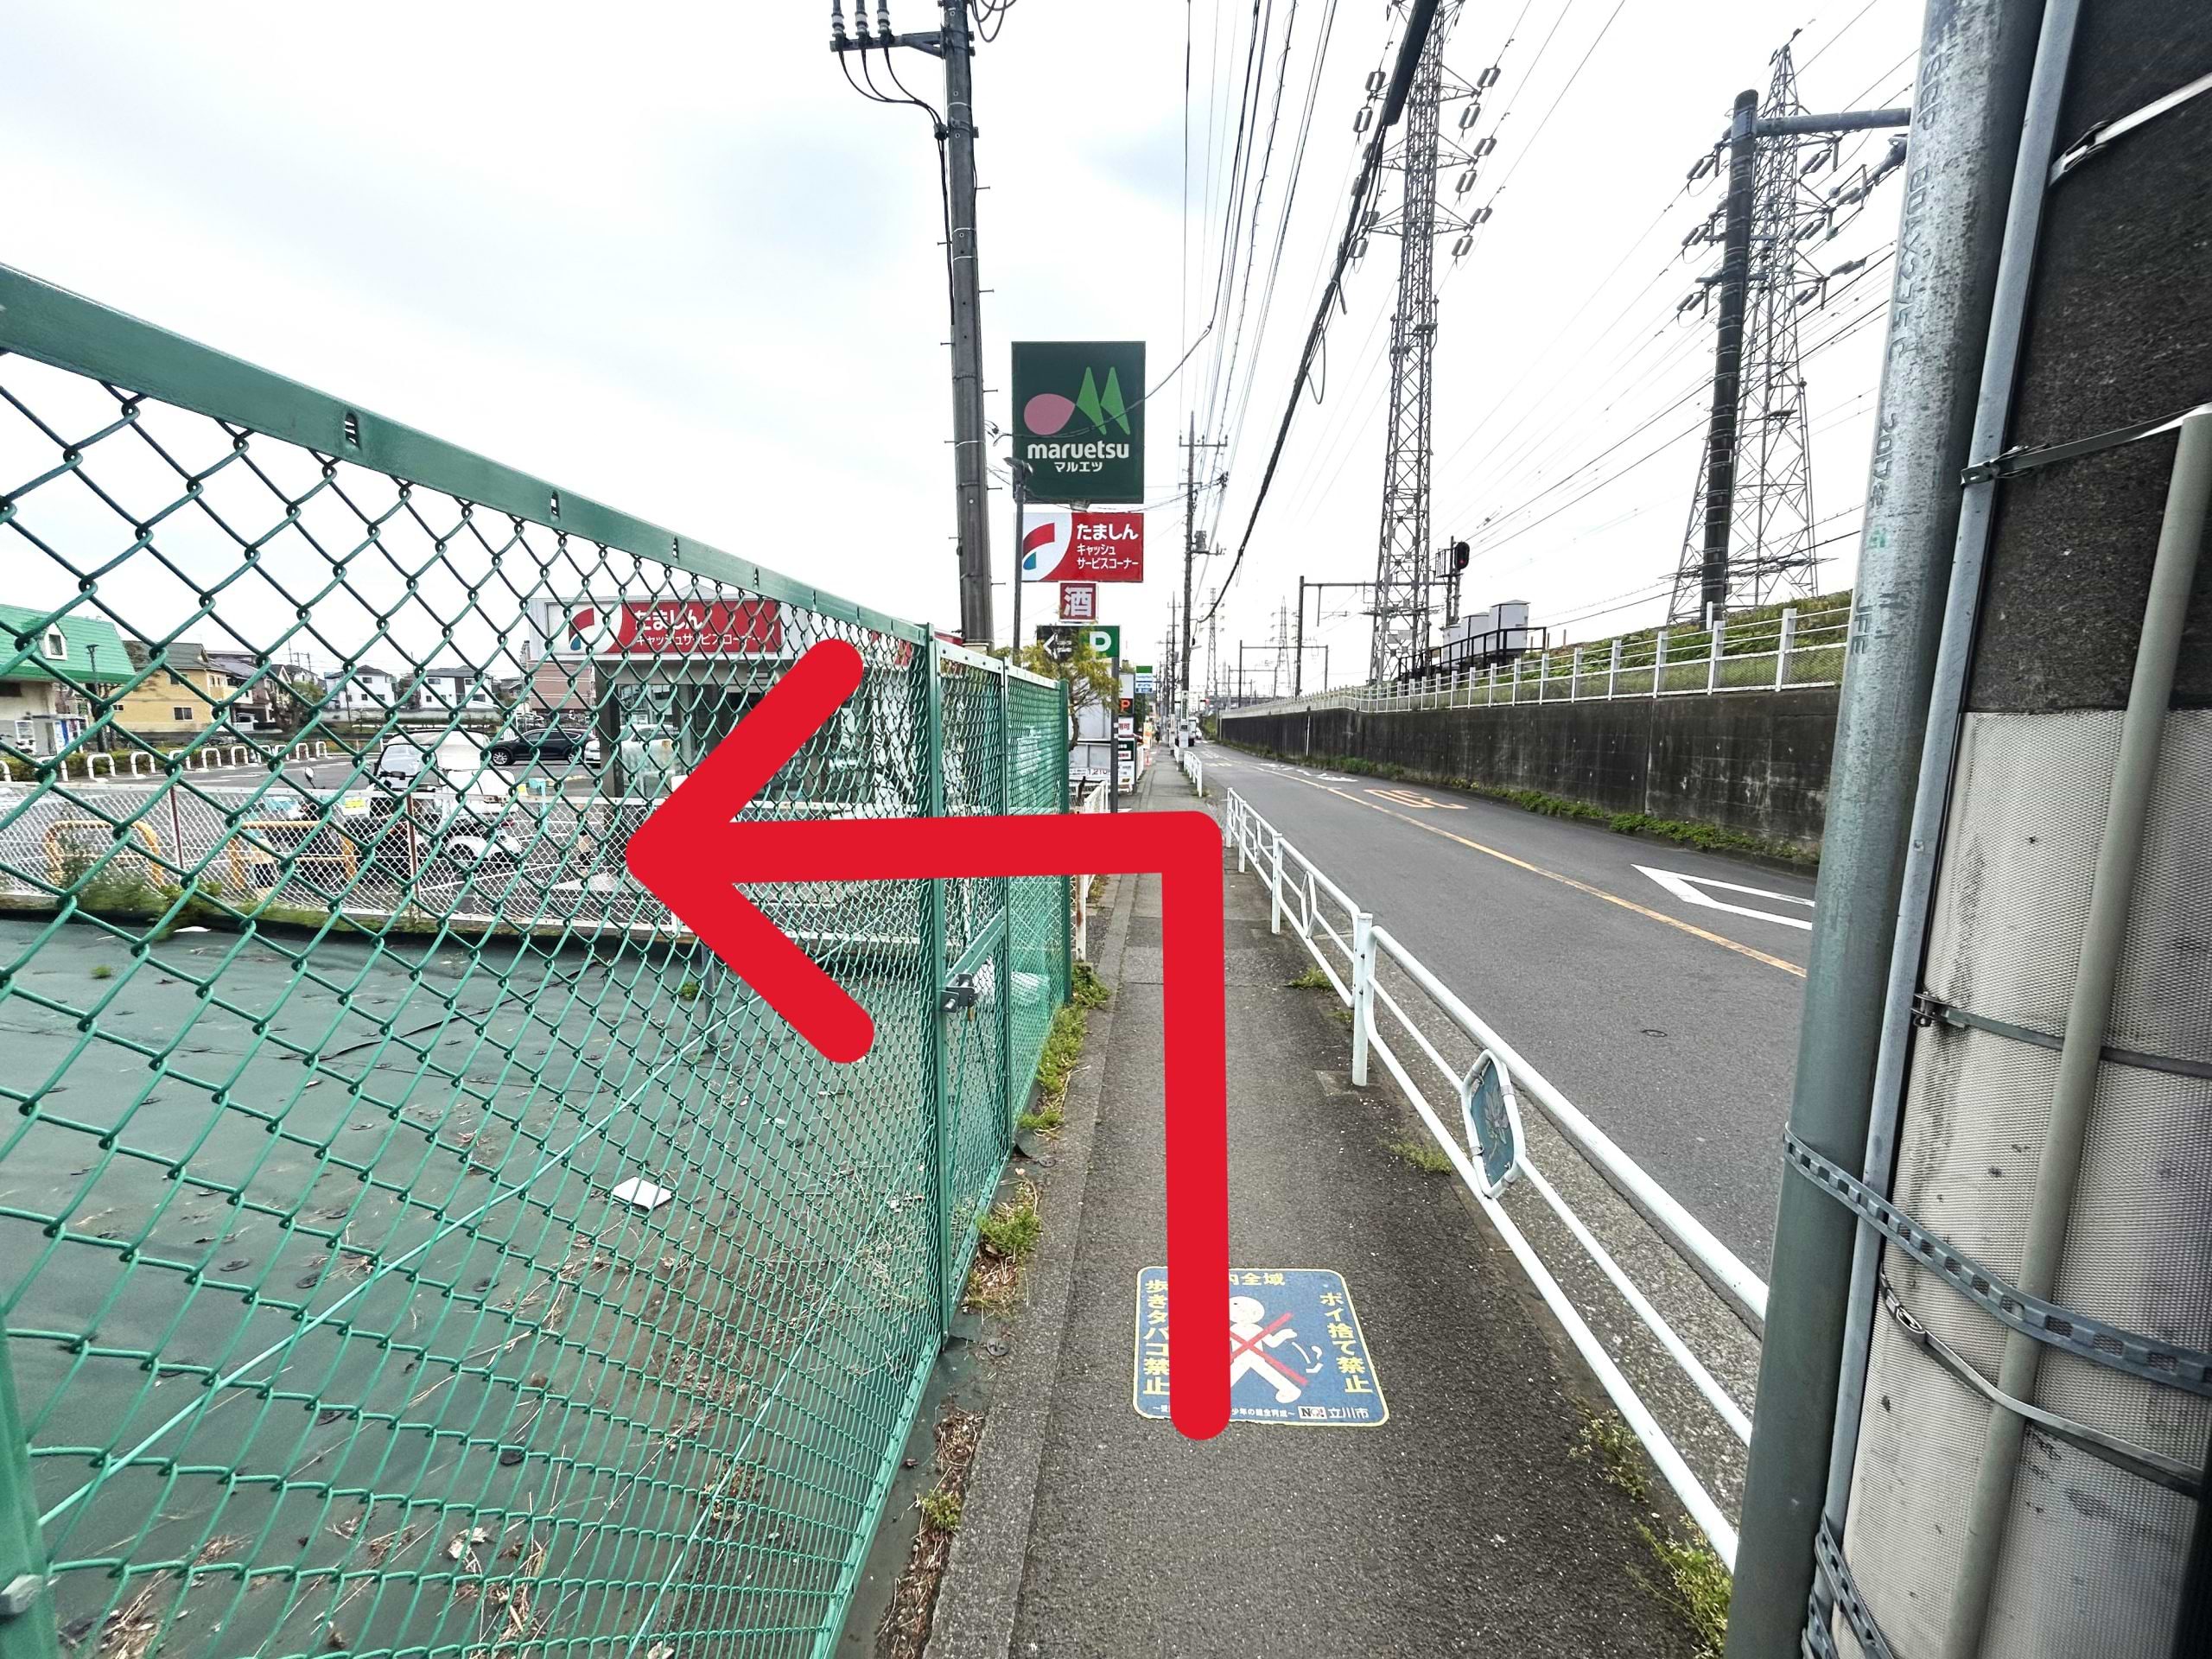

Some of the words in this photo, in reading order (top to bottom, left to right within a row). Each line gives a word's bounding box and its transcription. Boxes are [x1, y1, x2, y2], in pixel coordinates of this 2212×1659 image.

[1027, 441, 1129, 459] maruetsu
[1054, 461, 1103, 473] マルエツ
[1077, 524, 1139, 540] たましん
[1077, 543, 1116, 556] キャッシュ
[1077, 557, 1139, 569] サービスコーナー
[1064, 586, 1092, 617] 酒
[634, 609, 703, 631] たましん
[1851, 594, 1873, 655] JFE
[636, 633, 761, 645] キャッシュサビスコーナー
[1319, 1292, 1374, 1394] ポイ捨て禁止
[1328, 1408, 1370, 1419] 立川市
